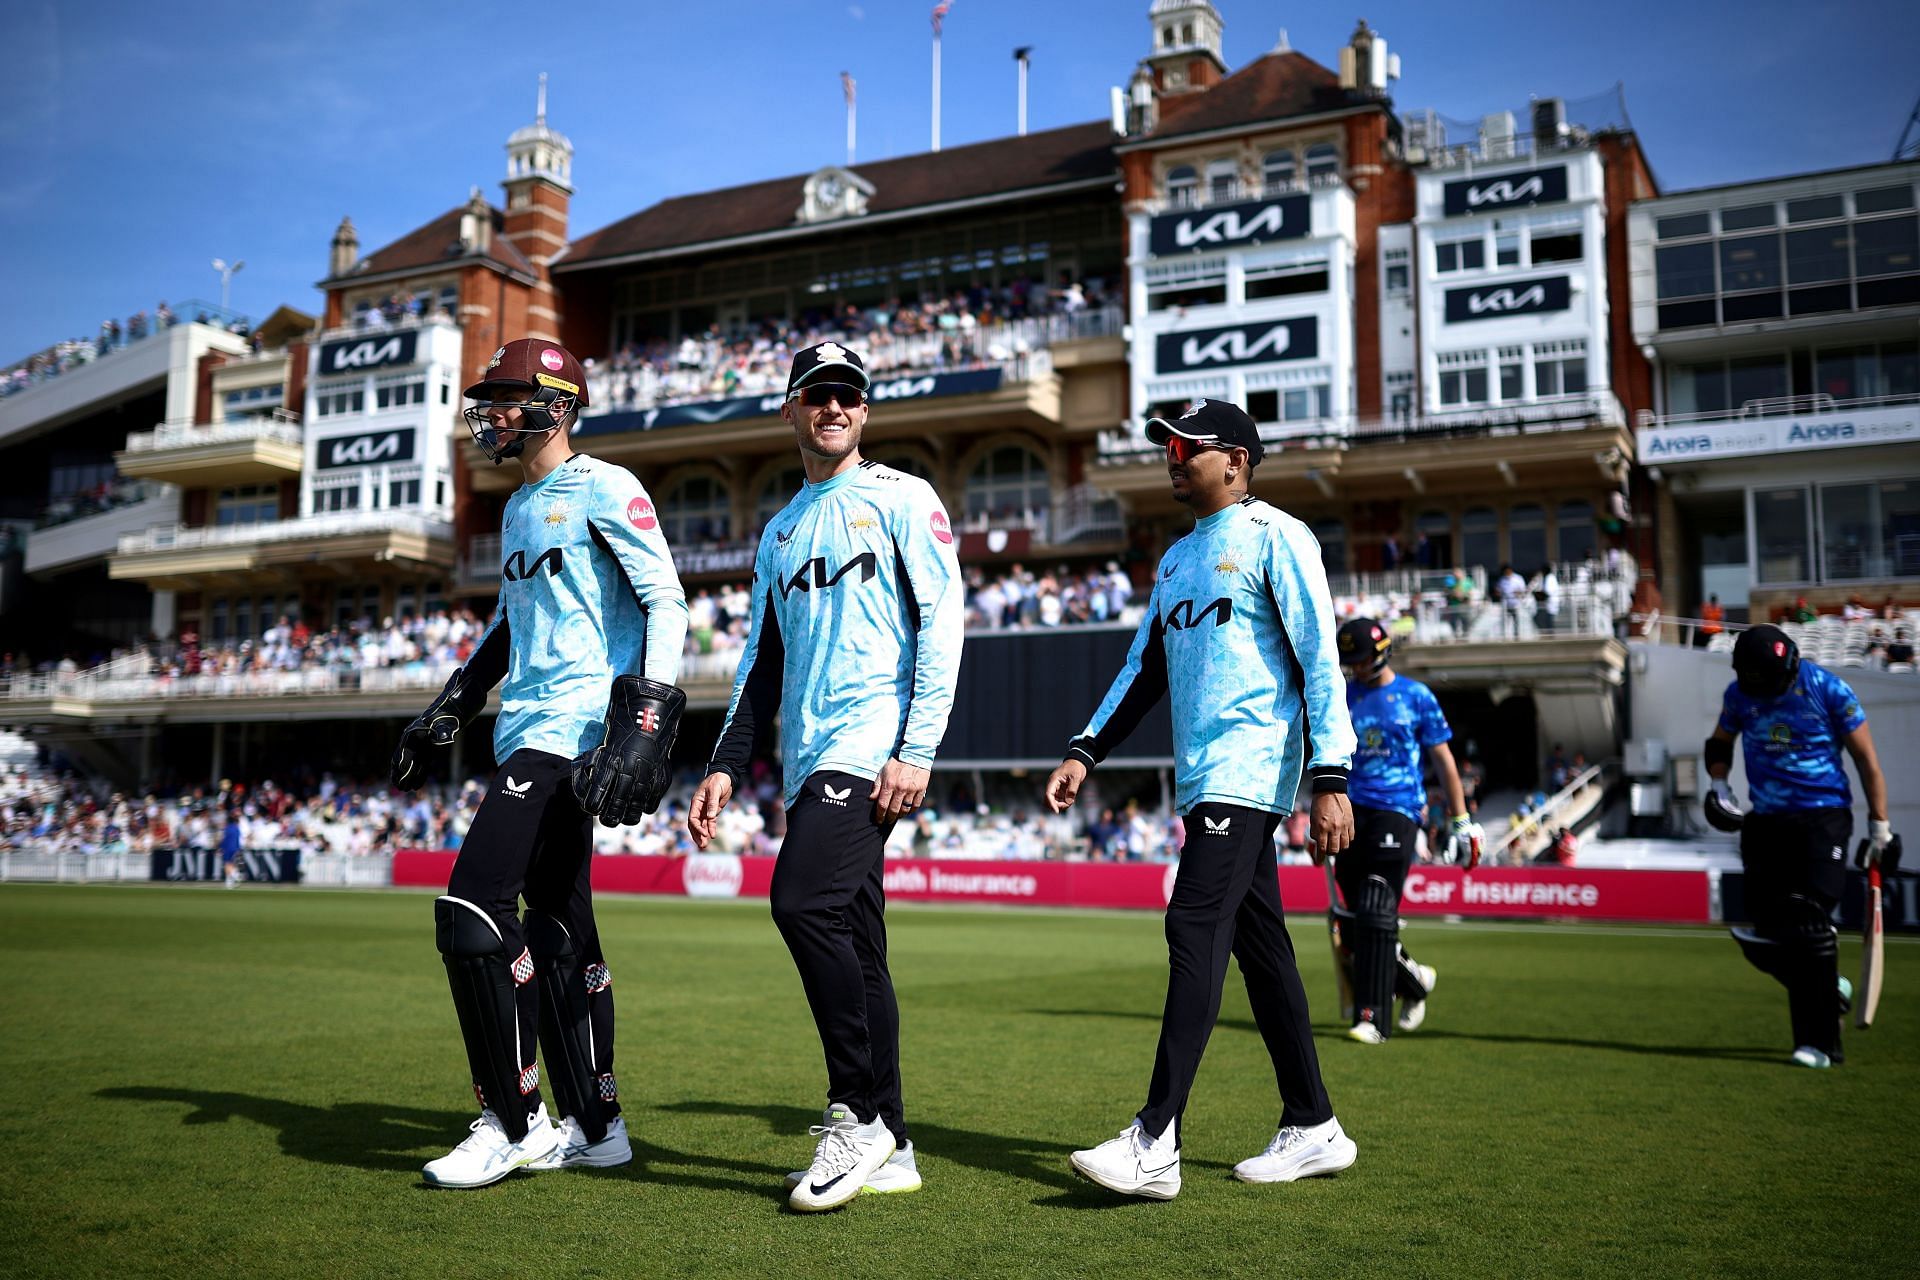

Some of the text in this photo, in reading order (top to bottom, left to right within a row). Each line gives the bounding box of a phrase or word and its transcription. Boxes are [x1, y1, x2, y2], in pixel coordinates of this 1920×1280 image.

[1467, 176, 1543, 206] KIA
[1176, 204, 1284, 247] KIA
[1469, 284, 1545, 314] KIA
[333, 337, 401, 369] KIA
[1182, 324, 1291, 365] KIA
[1649, 434, 1712, 455] Arora
[1788, 420, 1855, 444] Arora
[331, 432, 399, 465] KIA
[777, 552, 876, 602] KIA
[1163, 597, 1233, 635] KIA
[930, 867, 1038, 896] insurance
[1403, 873, 1599, 907] Car insurance
